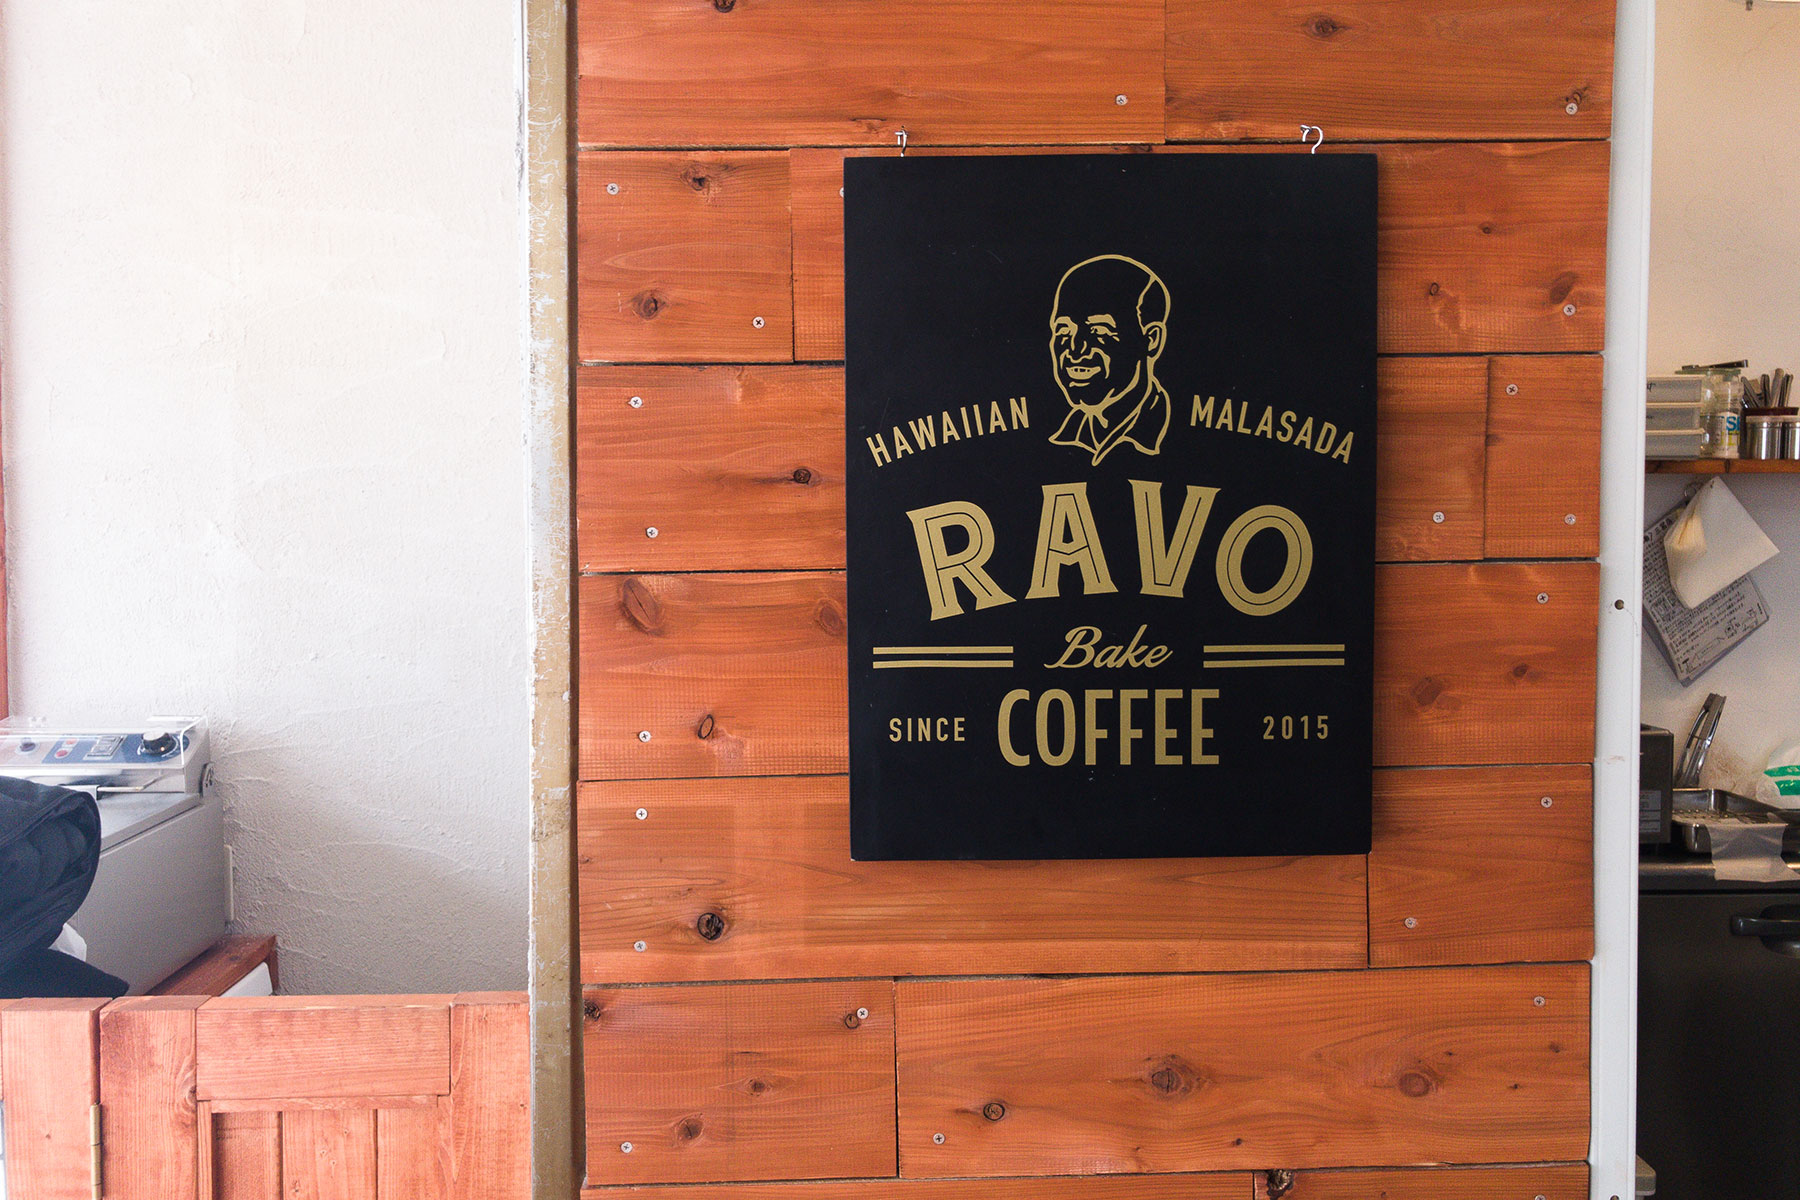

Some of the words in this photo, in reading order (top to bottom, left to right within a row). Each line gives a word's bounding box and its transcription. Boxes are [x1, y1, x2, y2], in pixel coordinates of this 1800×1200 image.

[866, 396, 1029, 467] HAWAIIAN
[1190, 395, 1354, 464] MALASADA
[906, 479, 1313, 621] RAVO
[1044, 624, 1173, 669] Bake
[889, 718, 966, 742] SINCE
[997, 689, 1220, 766] COFFEE
[1263, 715, 1329, 740] 2015
